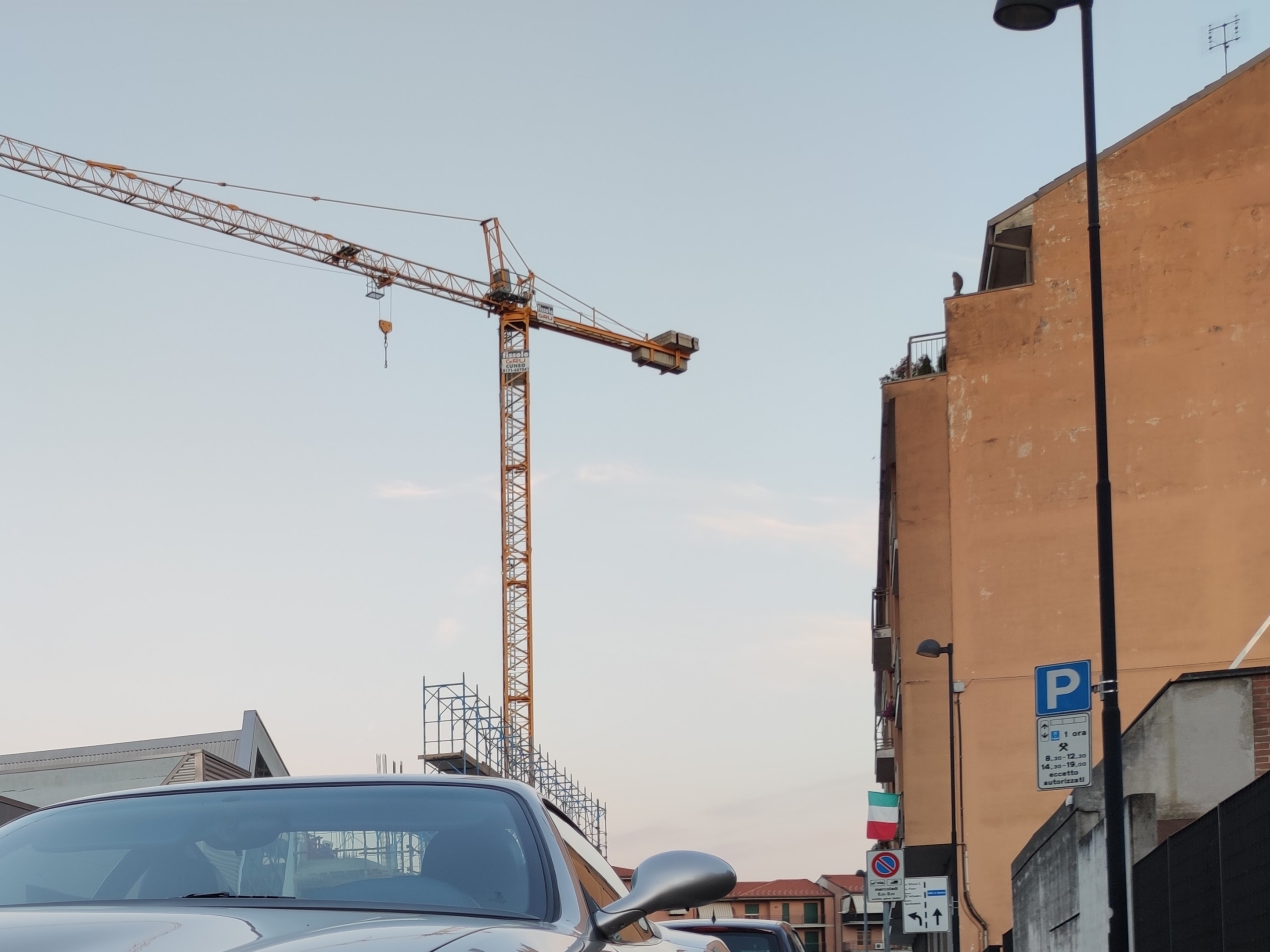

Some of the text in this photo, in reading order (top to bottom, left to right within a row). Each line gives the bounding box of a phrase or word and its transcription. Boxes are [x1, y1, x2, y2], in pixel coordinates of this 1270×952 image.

[1046, 668, 1080, 710] P
[1049, 770, 1079, 778] eccetto
[1043, 776, 1085, 786] autorizzati
